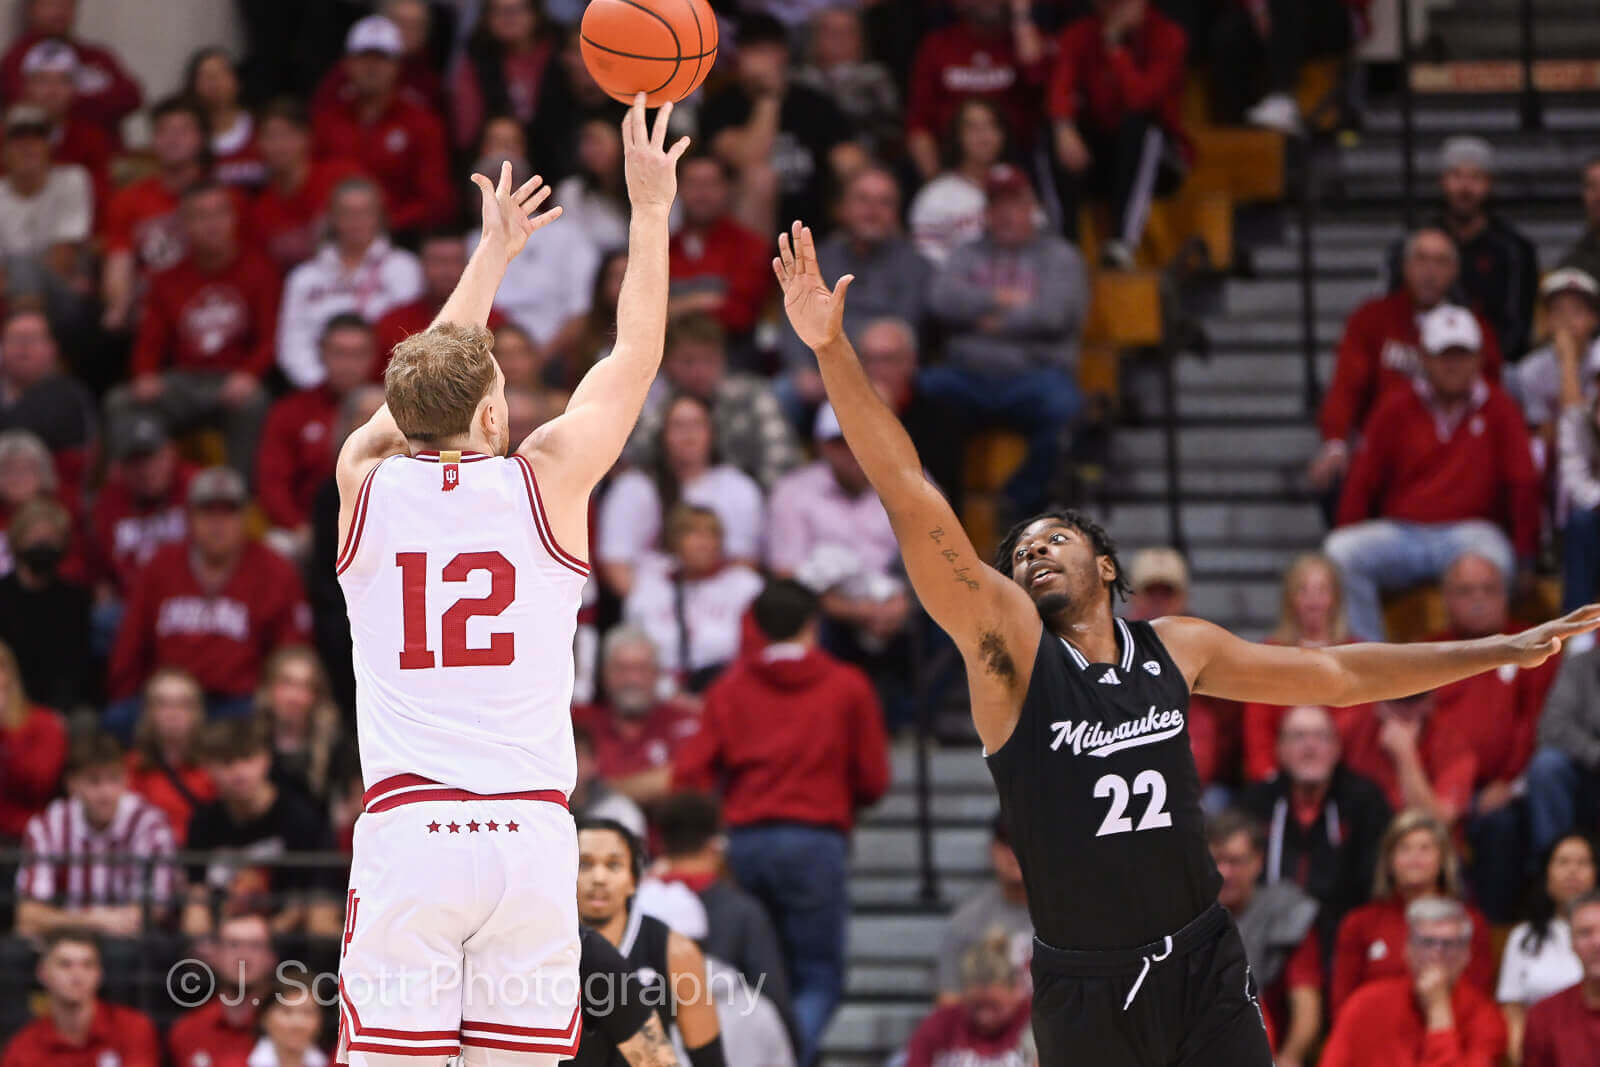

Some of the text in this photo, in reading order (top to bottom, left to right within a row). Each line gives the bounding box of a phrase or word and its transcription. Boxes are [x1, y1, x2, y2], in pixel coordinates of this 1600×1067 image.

[395, 550, 517, 670] 12
[1050, 705, 1184, 756] Milwaukee
[1093, 769, 1173, 837] 22
